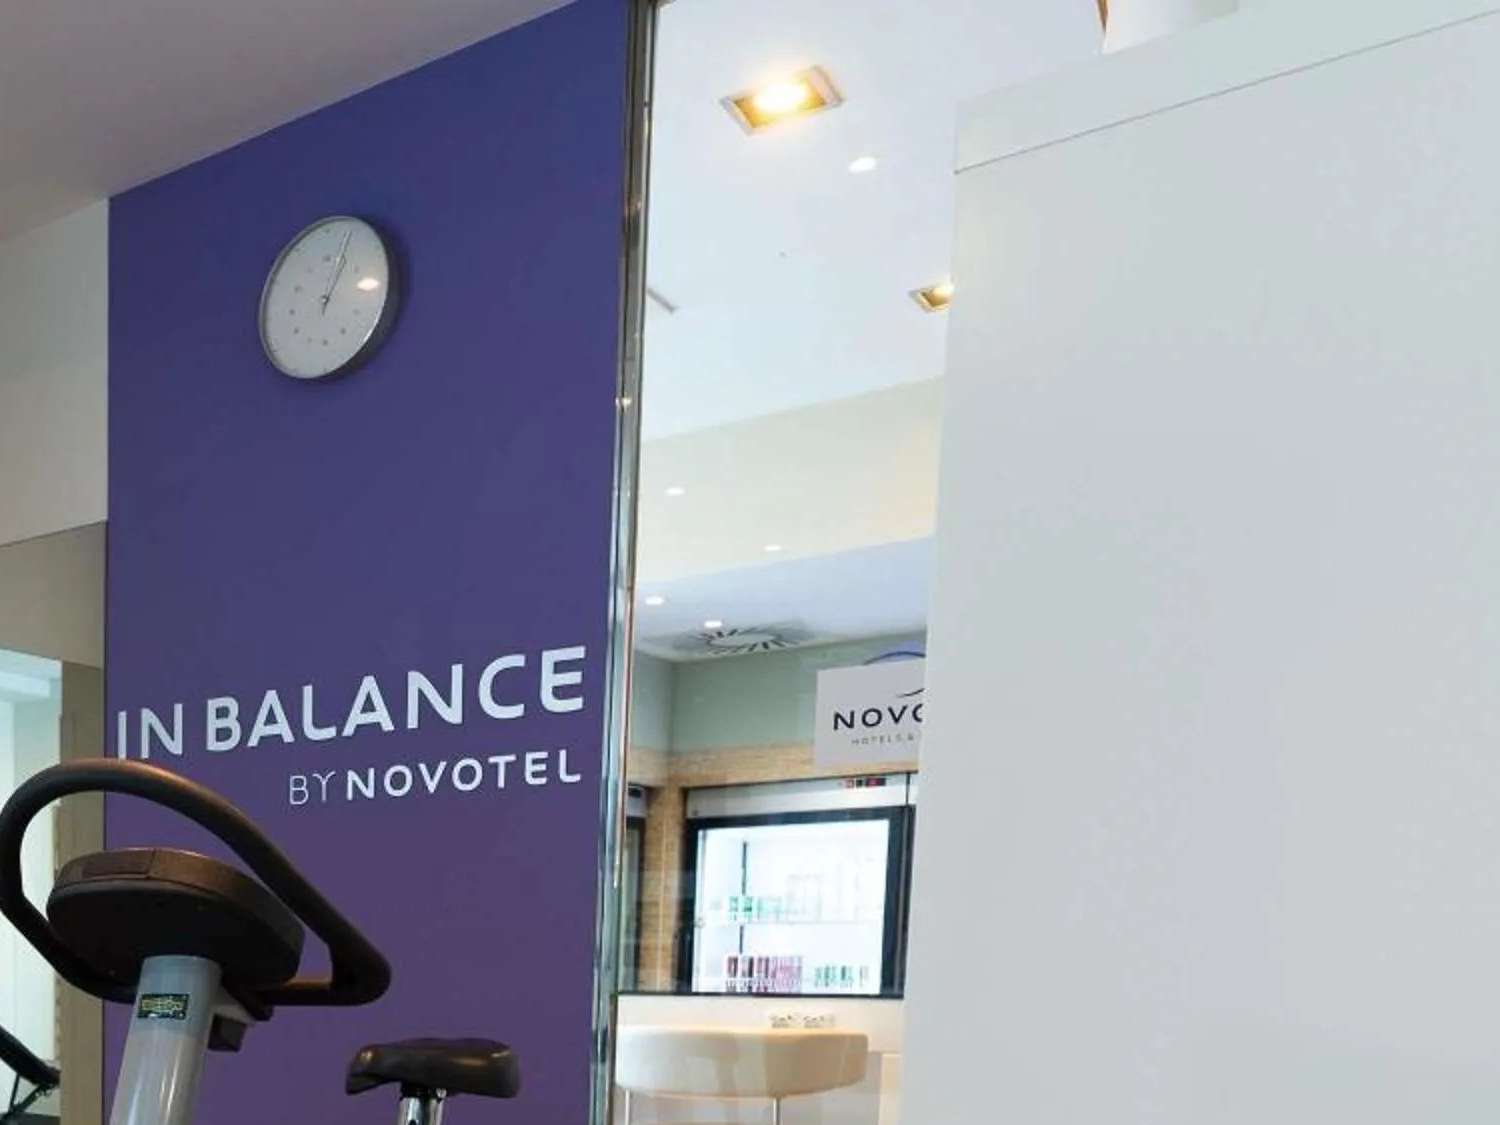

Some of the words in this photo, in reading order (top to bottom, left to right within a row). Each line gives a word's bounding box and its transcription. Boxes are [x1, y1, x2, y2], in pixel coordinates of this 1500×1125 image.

[117, 703, 183, 760] IN
[206, 645, 586, 752] BALANCE
[289, 771, 335, 805] BY
[346, 749, 581, 800] NOVOTEL
